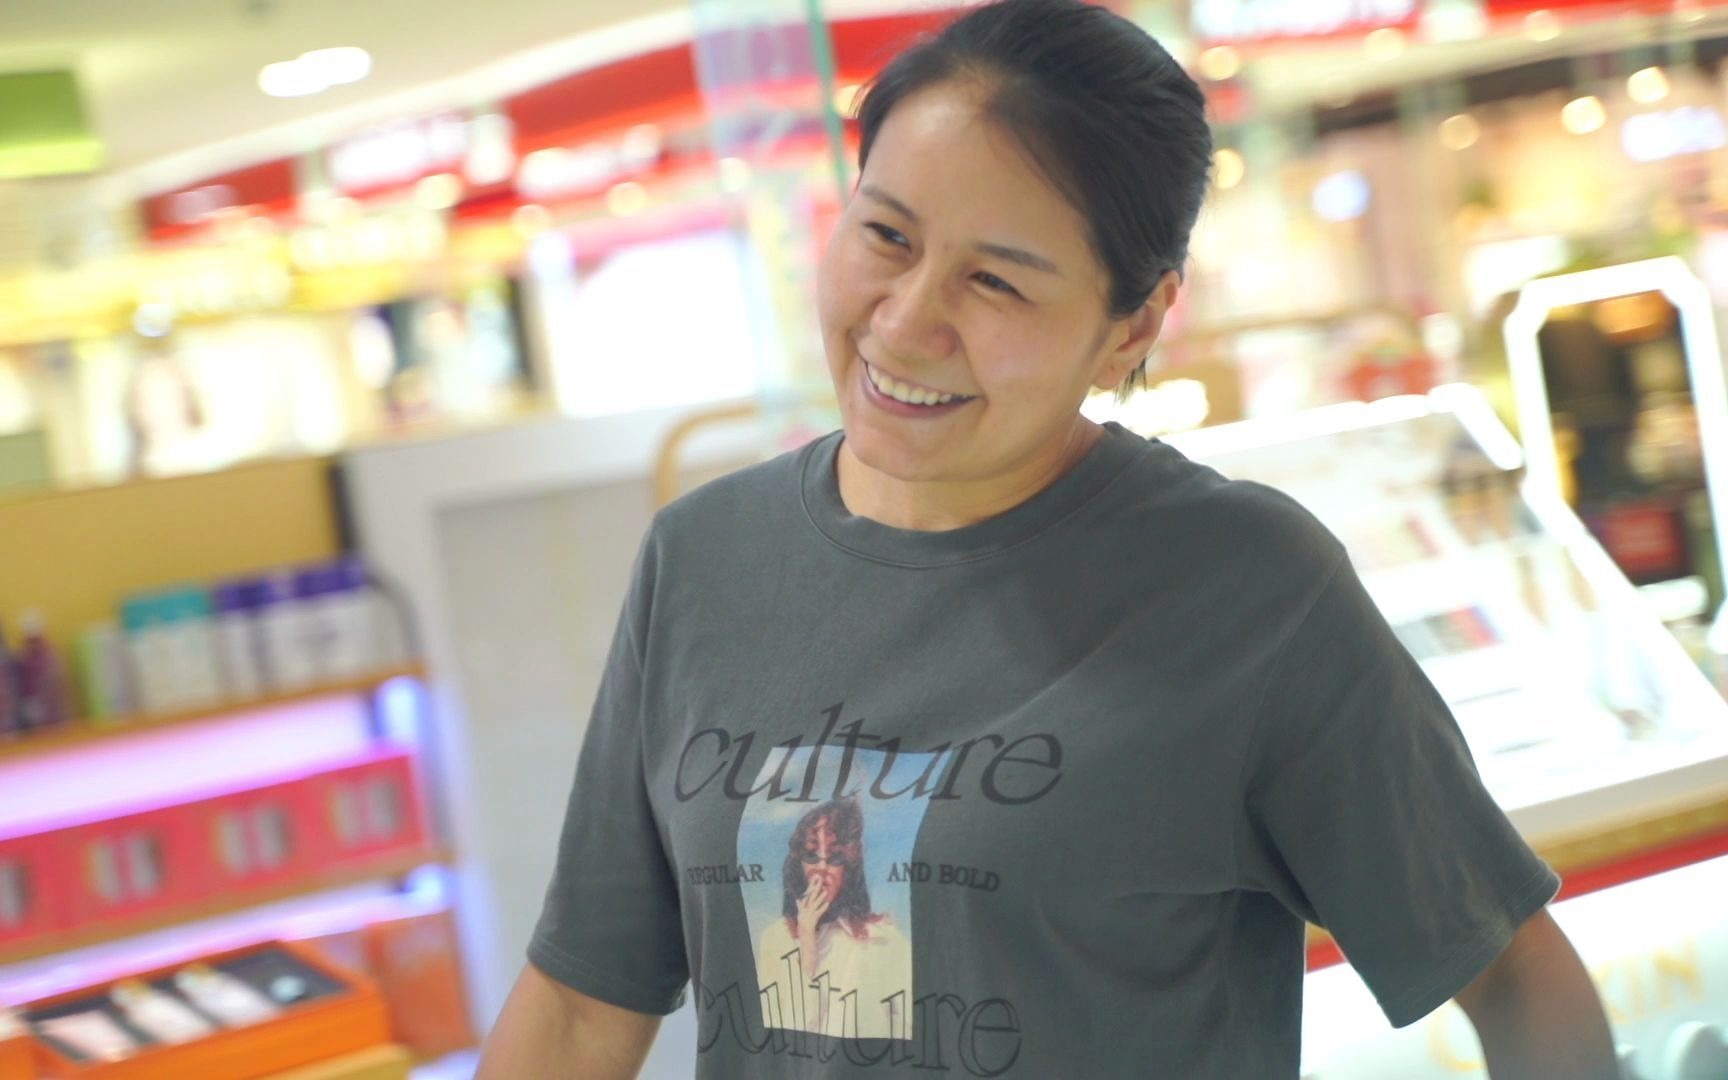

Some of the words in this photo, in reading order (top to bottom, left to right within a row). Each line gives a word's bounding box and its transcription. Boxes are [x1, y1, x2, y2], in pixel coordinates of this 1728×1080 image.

[675, 703, 1063, 805] culture
[687, 864, 765, 885] REGULAR
[887, 862, 931, 883] AND
[939, 864, 1001, 892] BOLD
